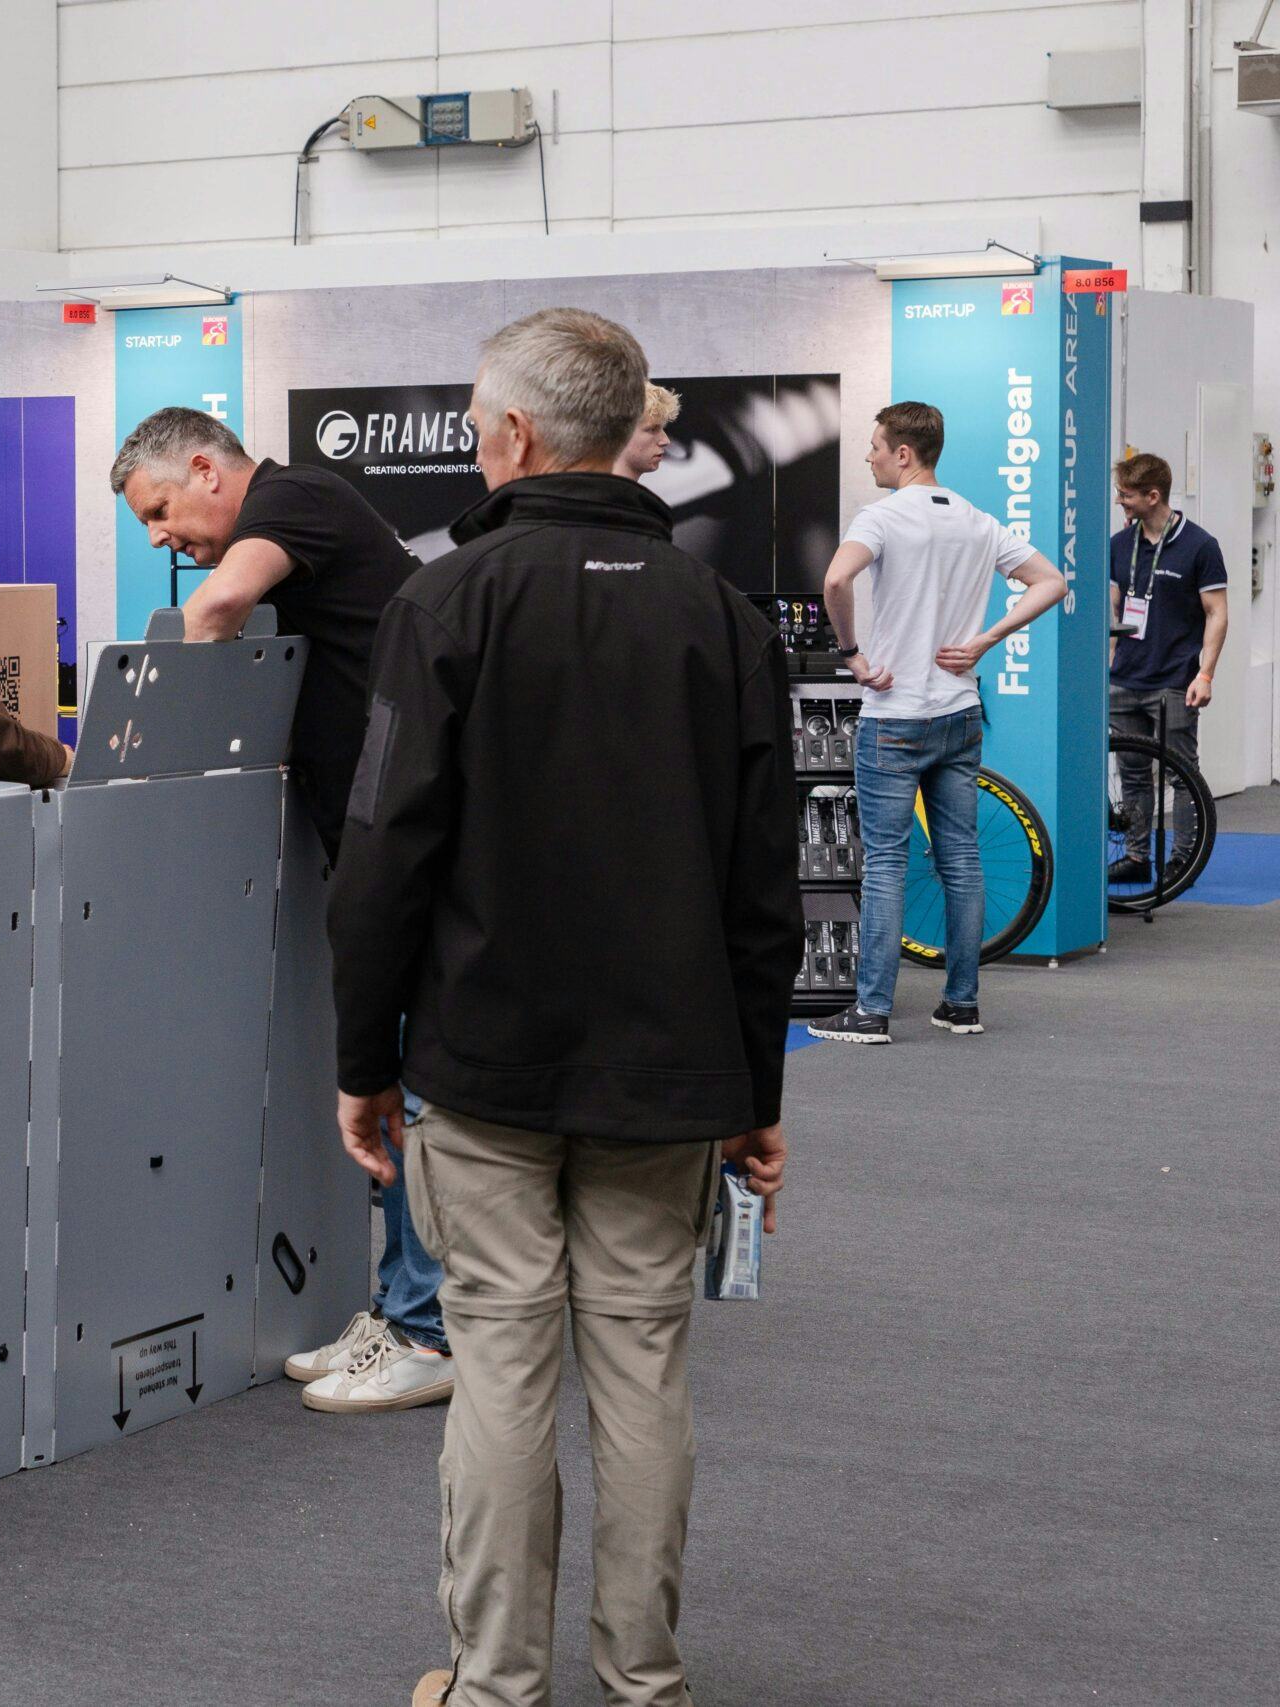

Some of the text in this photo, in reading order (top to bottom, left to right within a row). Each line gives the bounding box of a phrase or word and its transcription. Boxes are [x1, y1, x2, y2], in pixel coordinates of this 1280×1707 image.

[1075, 277, 1115, 288] 8.0 B56
[904, 303, 976, 319] START-UP
[125, 335, 182, 348] START-UP
[364, 411, 482, 454] FRAMES
[364, 464, 484, 475] CREATING COMPONENTS FO
[1064, 408, 1078, 616] START-UP
[140, 1338, 177, 1358] This way up
